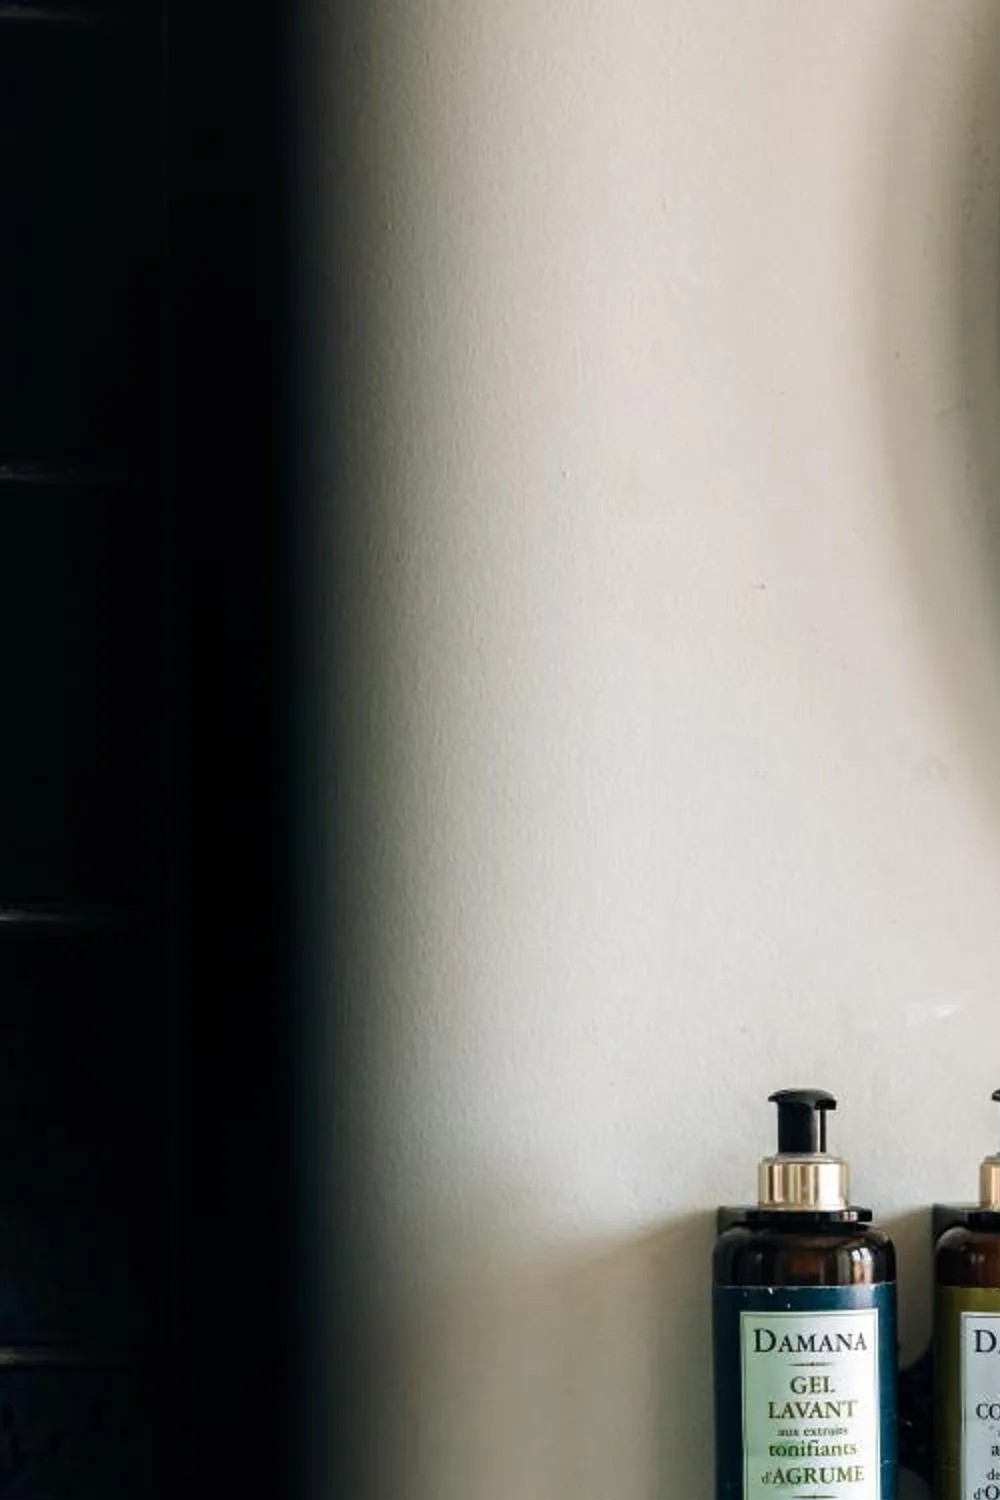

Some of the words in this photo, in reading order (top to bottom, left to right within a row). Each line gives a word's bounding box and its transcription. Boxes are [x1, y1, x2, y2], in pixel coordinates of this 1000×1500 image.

[753, 1328, 867, 1352] DAMANA
[790, 1376, 835, 1394] GEL
[769, 1402, 858, 1420] LAVANT
[777, 1428, 799, 1437] aux
[803, 1425, 848, 1437] extraits
[769, 1439, 857, 1457] tonifiants
[761, 1465, 864, 1485] d'AGRUME
[987, 1469, 1000, 1480] de
